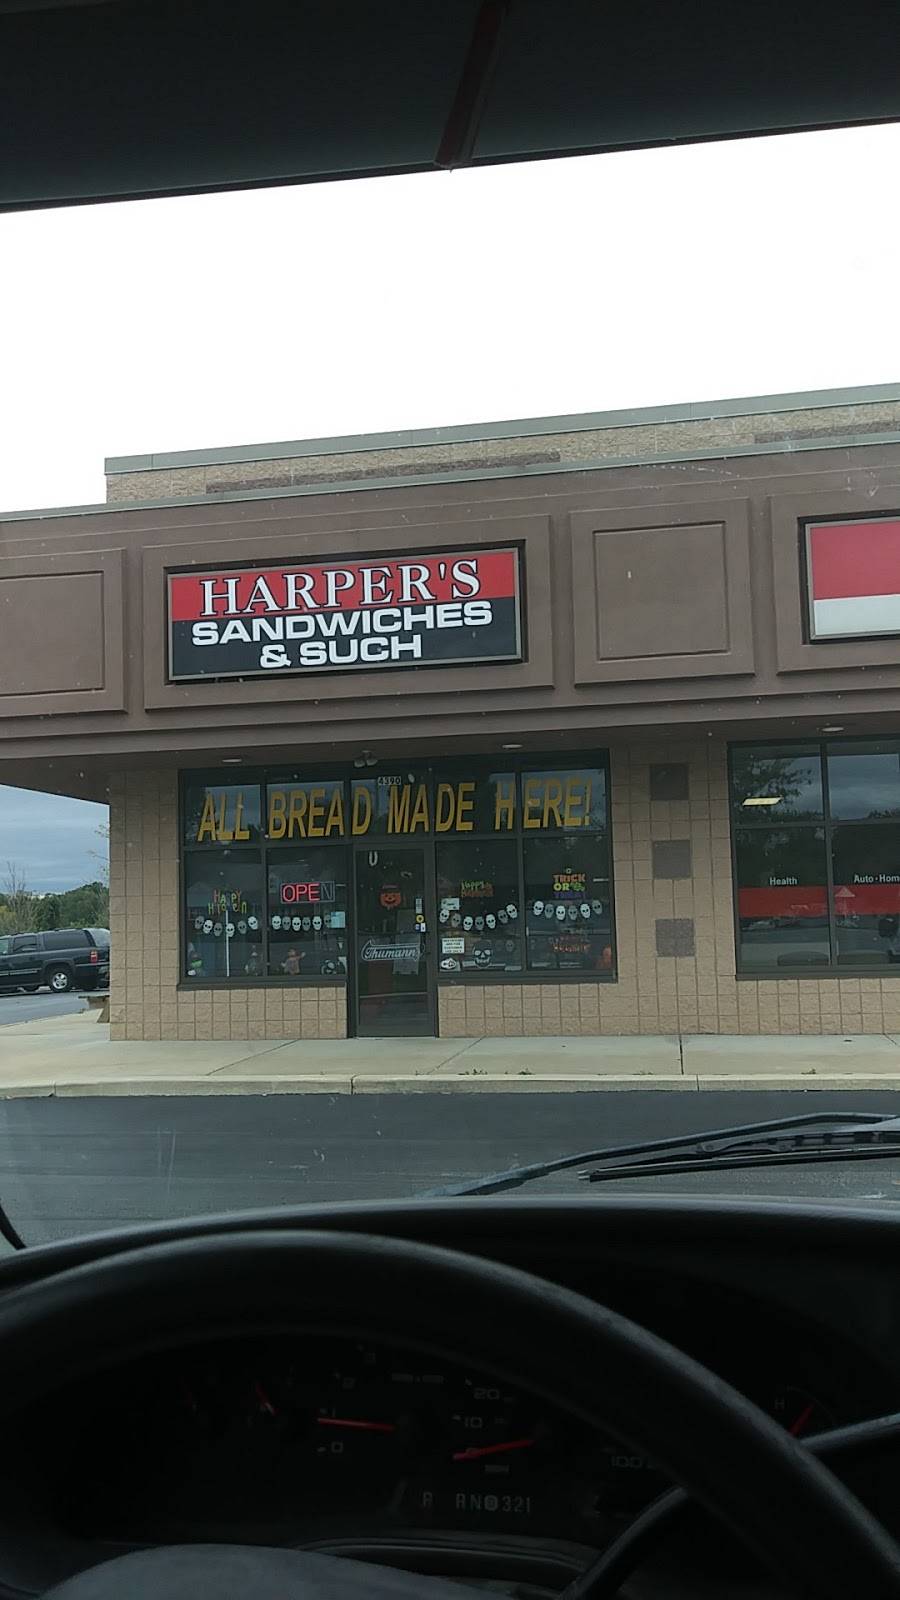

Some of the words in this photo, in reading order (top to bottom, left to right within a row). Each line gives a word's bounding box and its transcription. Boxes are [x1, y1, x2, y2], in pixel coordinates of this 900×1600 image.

[200, 559, 481, 616] HARPER'S
[191, 600, 493, 646] SANDWICHES
[259, 643, 292, 669] &
[299, 633, 422, 667] SUCH
[197, 788, 251, 842] ALL
[268, 783, 372, 839] BREAD
[386, 783, 475, 834] MADE
[494, 778, 593, 830] HERE!
[281, 882, 334, 902] OPEN
[769, 876, 798, 886] Health
[854, 873, 874, 884] Auto
